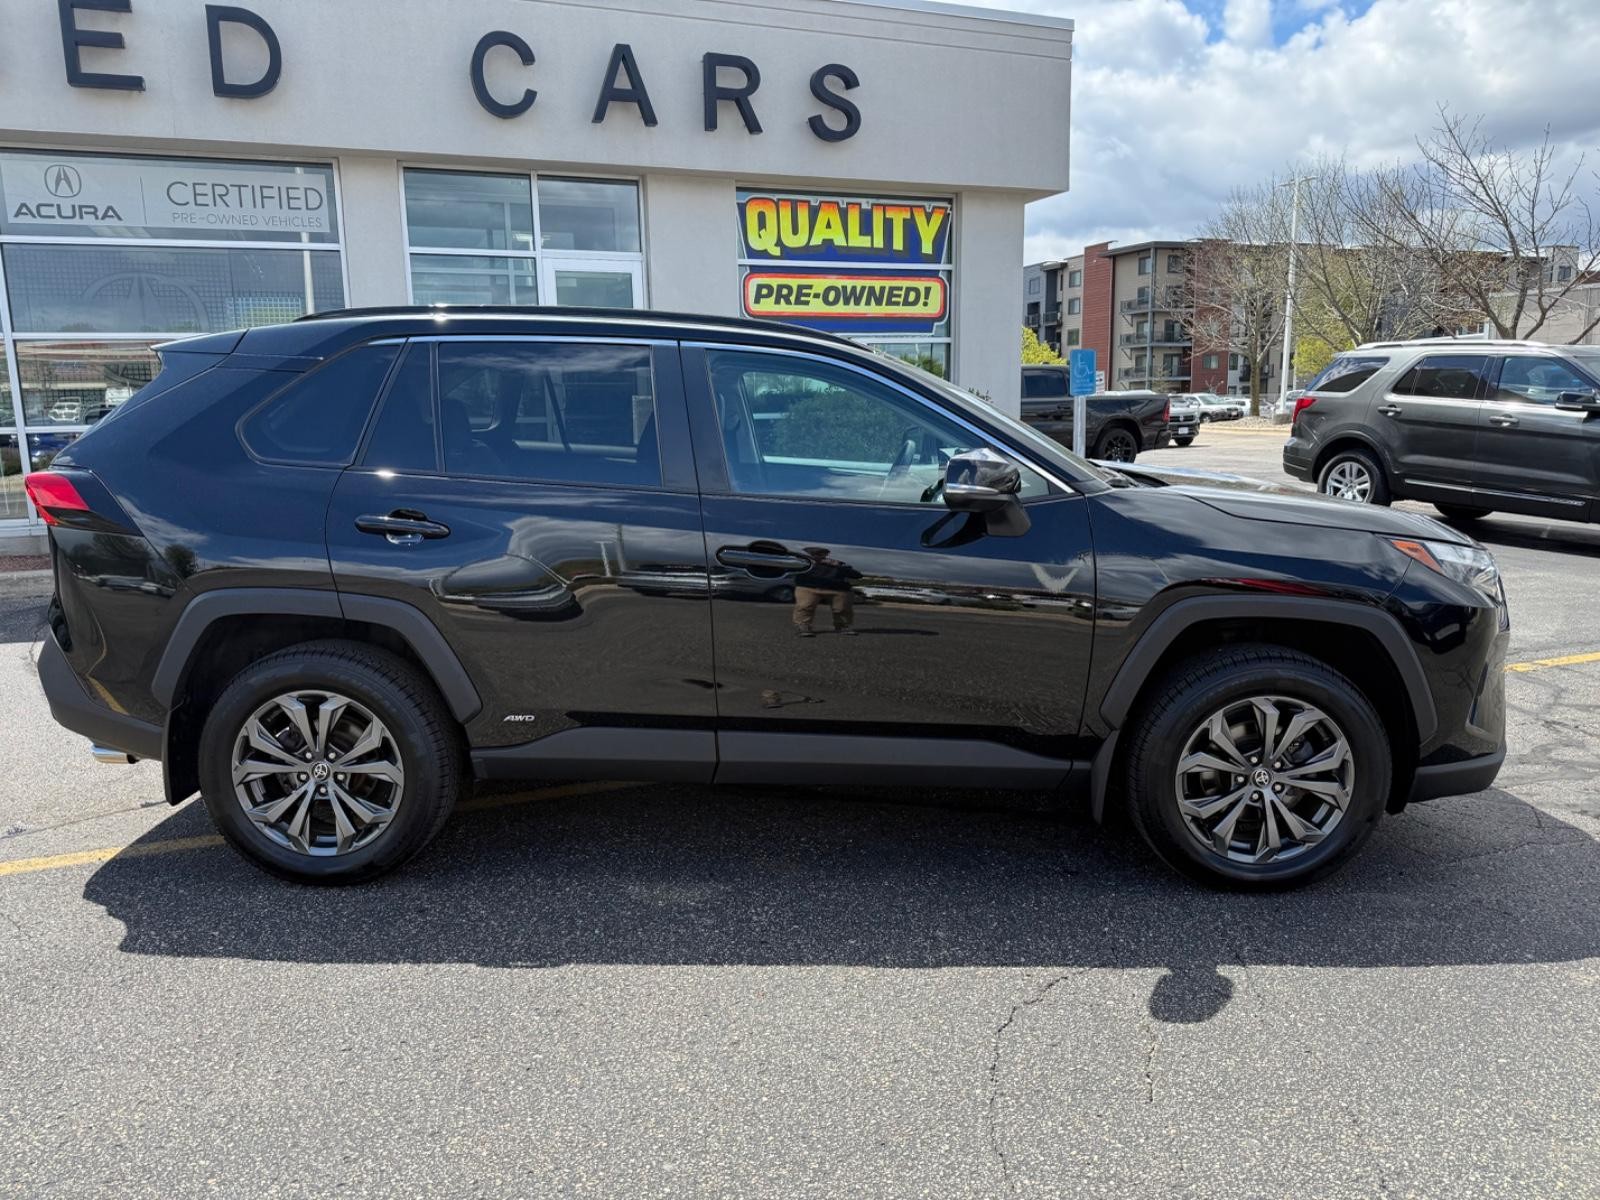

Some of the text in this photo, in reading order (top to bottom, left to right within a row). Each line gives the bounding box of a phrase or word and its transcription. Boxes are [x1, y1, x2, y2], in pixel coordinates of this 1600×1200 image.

[470, 30, 862, 142] CARS
[166, 182, 323, 211] CERTIFIED
[13, 203, 124, 221] ACURA
[172, 212, 323, 228] PRE-OWNED VEHICLES
[745, 197, 946, 256] QUALITY
[753, 283, 932, 307] PRE-OWNED!
